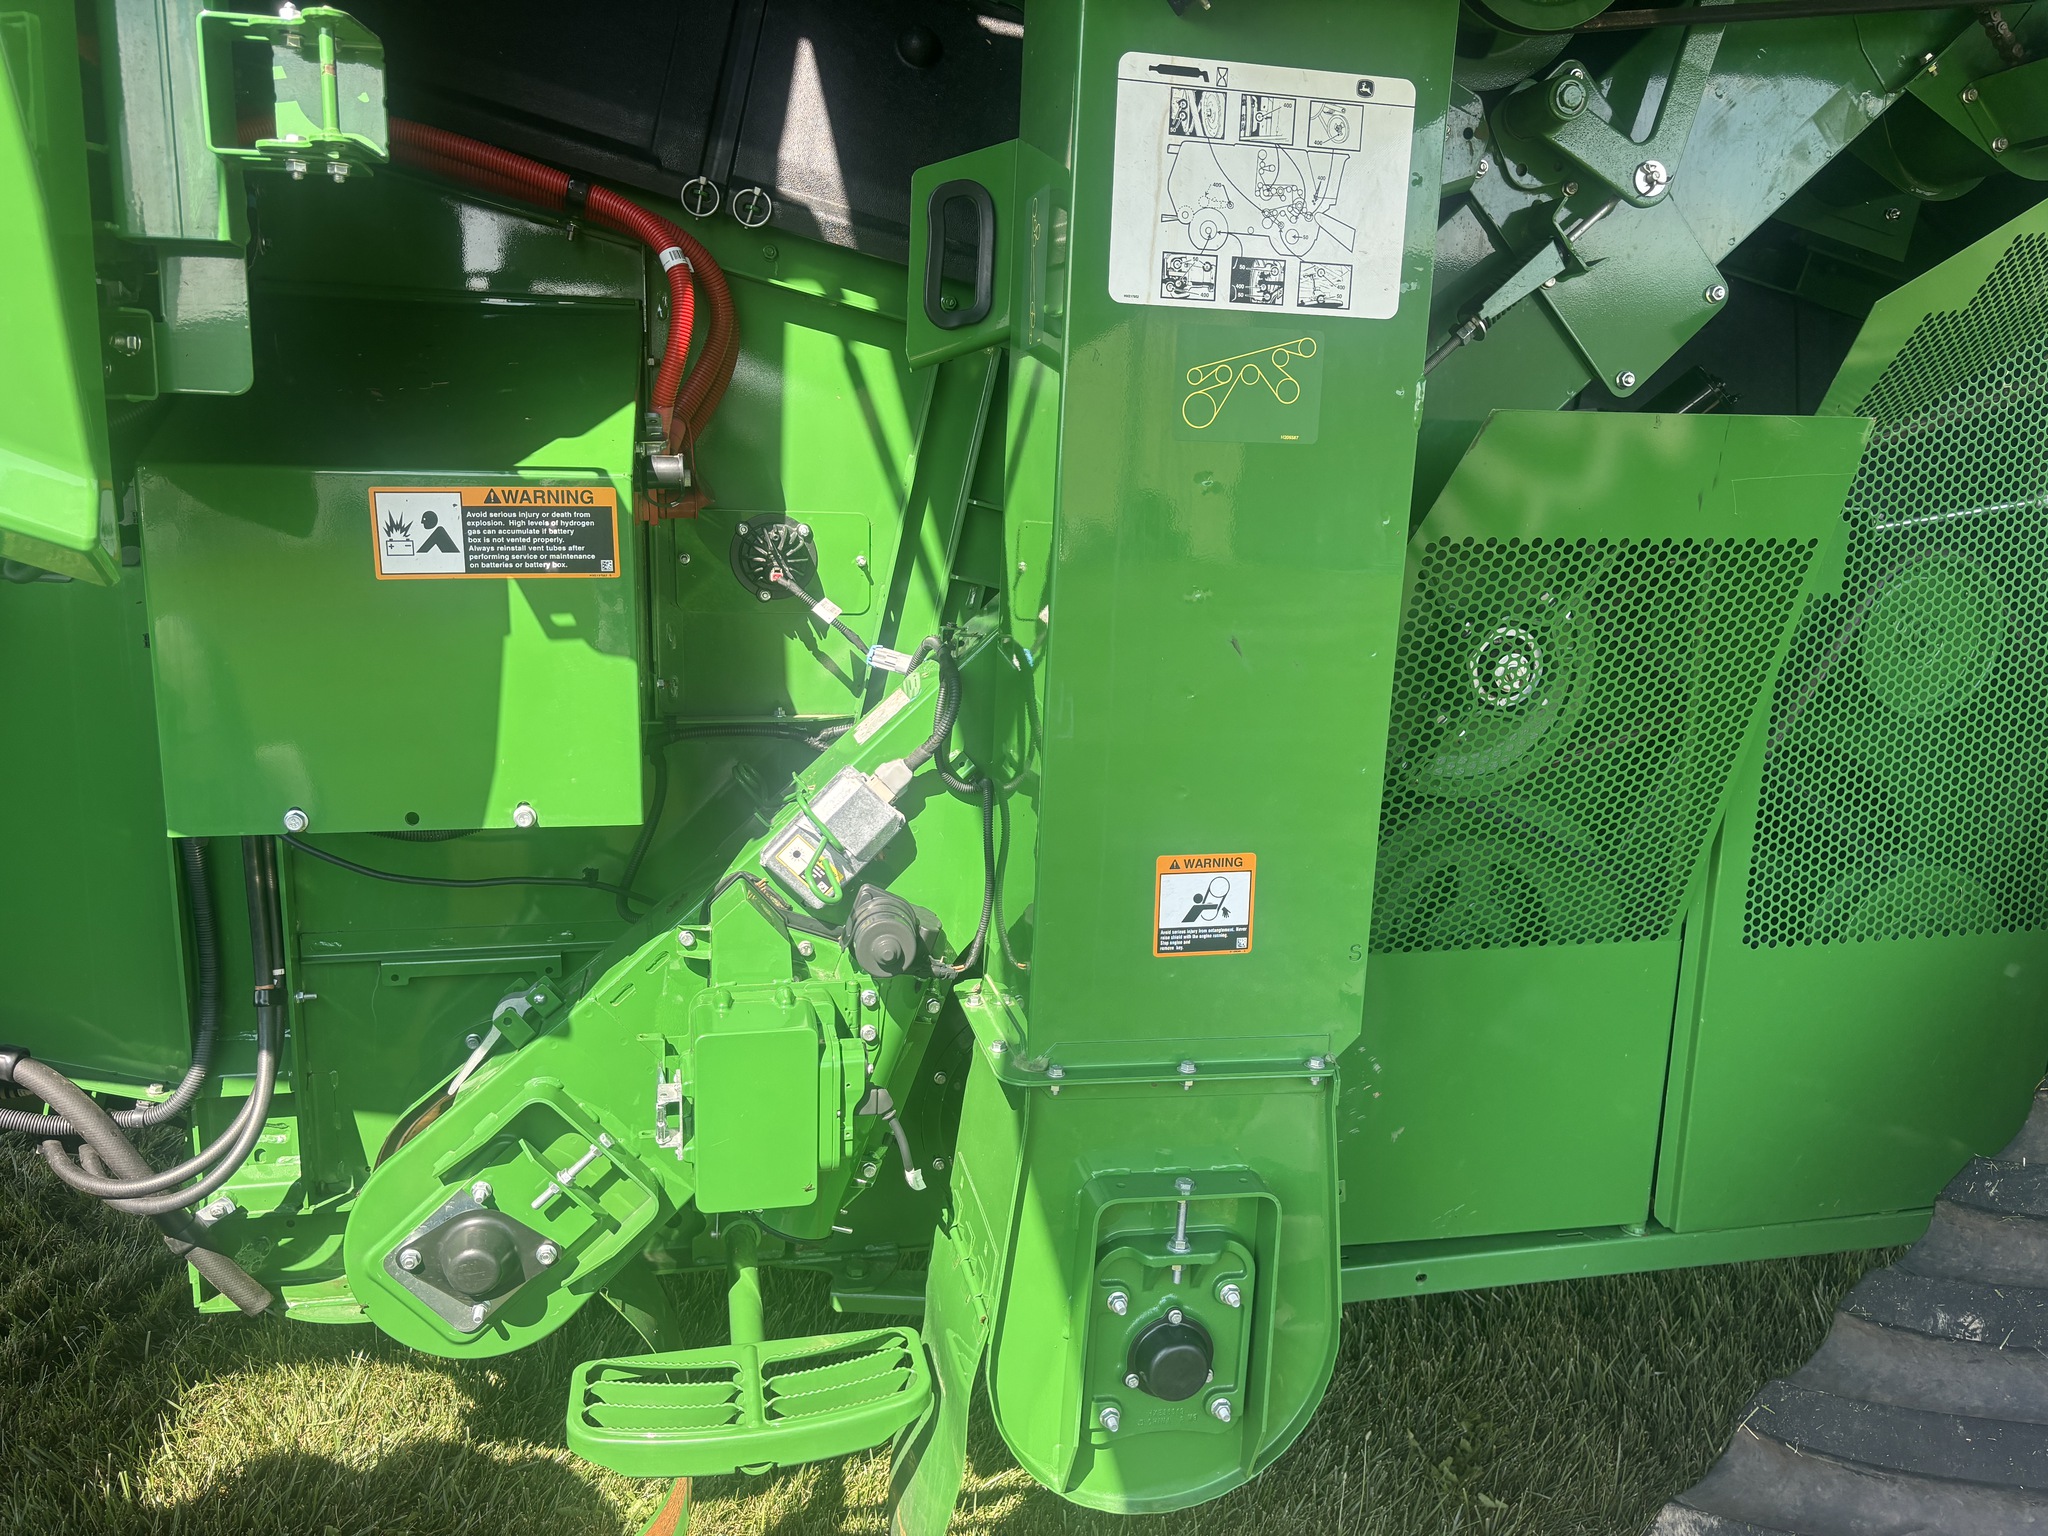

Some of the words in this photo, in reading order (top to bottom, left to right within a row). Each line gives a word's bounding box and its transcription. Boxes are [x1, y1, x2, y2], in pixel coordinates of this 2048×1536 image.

[501, 489, 594, 504] WARNING
[466, 511, 488, 519] Avoid
[489, 511, 517, 519] serious
[518, 511, 540, 519] injury
[541, 511, 550, 519] or
[551, 511, 572, 519] death
[573, 511, 591, 519] from
[466, 520, 505, 528] explosion.
[508, 520, 526, 528] High
[527, 520, 549, 528] levels
[550, 520, 559, 528] of
[560, 520, 595, 528] hydrogen
[467, 528, 481, 536] gas
[482, 528, 496, 536] can
[498, 528, 540, 536] accumulate
[541, 528, 547, 536] if
[548, 528, 575, 536] battery
[468, 536, 482, 544] box
[483, 536, 490, 544] is
[492, 536, 504, 544] not
[506, 536, 531, 544] vented
[532, 536, 565, 544] properly.
[469, 553, 510, 561] performing
[511, 553, 538, 561] service
[539, 553, 548, 561] or
[549, 553, 596, 561] maintenance
[469, 561, 480, 569] on
[481, 561, 513, 569] batteries
[514, 561, 523, 569] or
[524, 561, 551, 569] battery
[552, 561, 568, 569] box.
[1183, 857, 1243, 869] WARNING
[1348, 943, 1362, 962] S
